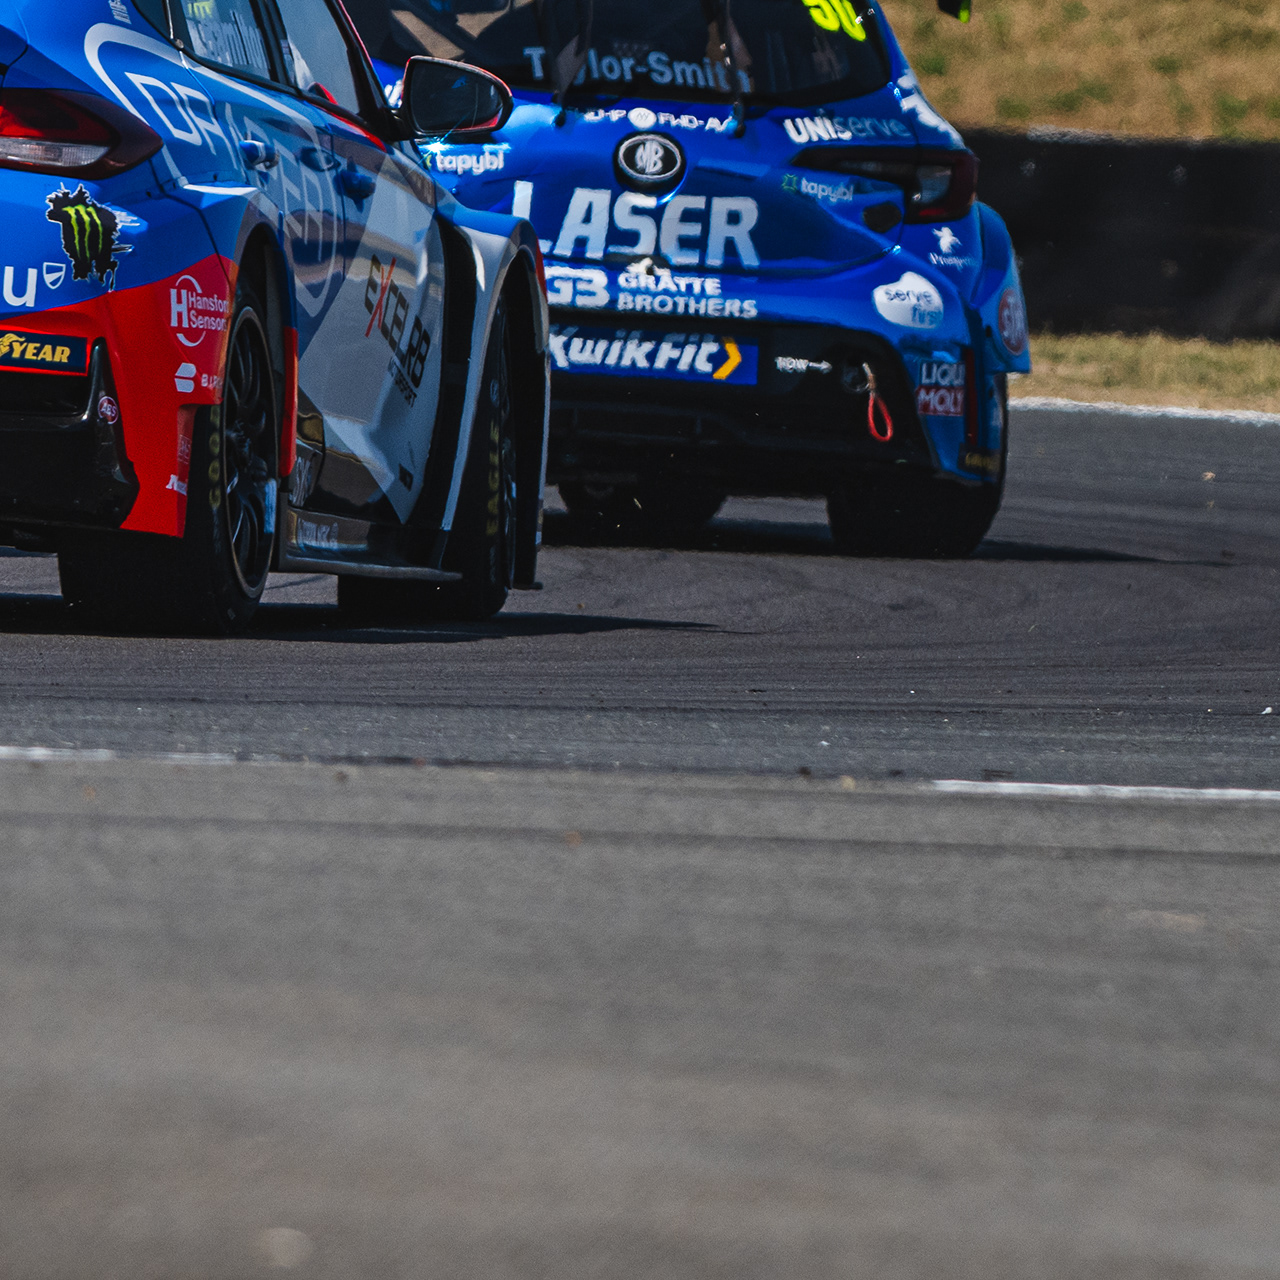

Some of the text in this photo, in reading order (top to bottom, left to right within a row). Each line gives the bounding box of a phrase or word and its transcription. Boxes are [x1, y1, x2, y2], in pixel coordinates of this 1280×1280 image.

[523, 46, 753, 94] Tlor-Smit
[435, 150, 504, 175] tapybl
[512, 179, 761, 269] LASER
[189, 292, 229, 314] Hansfor
[618, 292, 758, 318] BROTHERS
